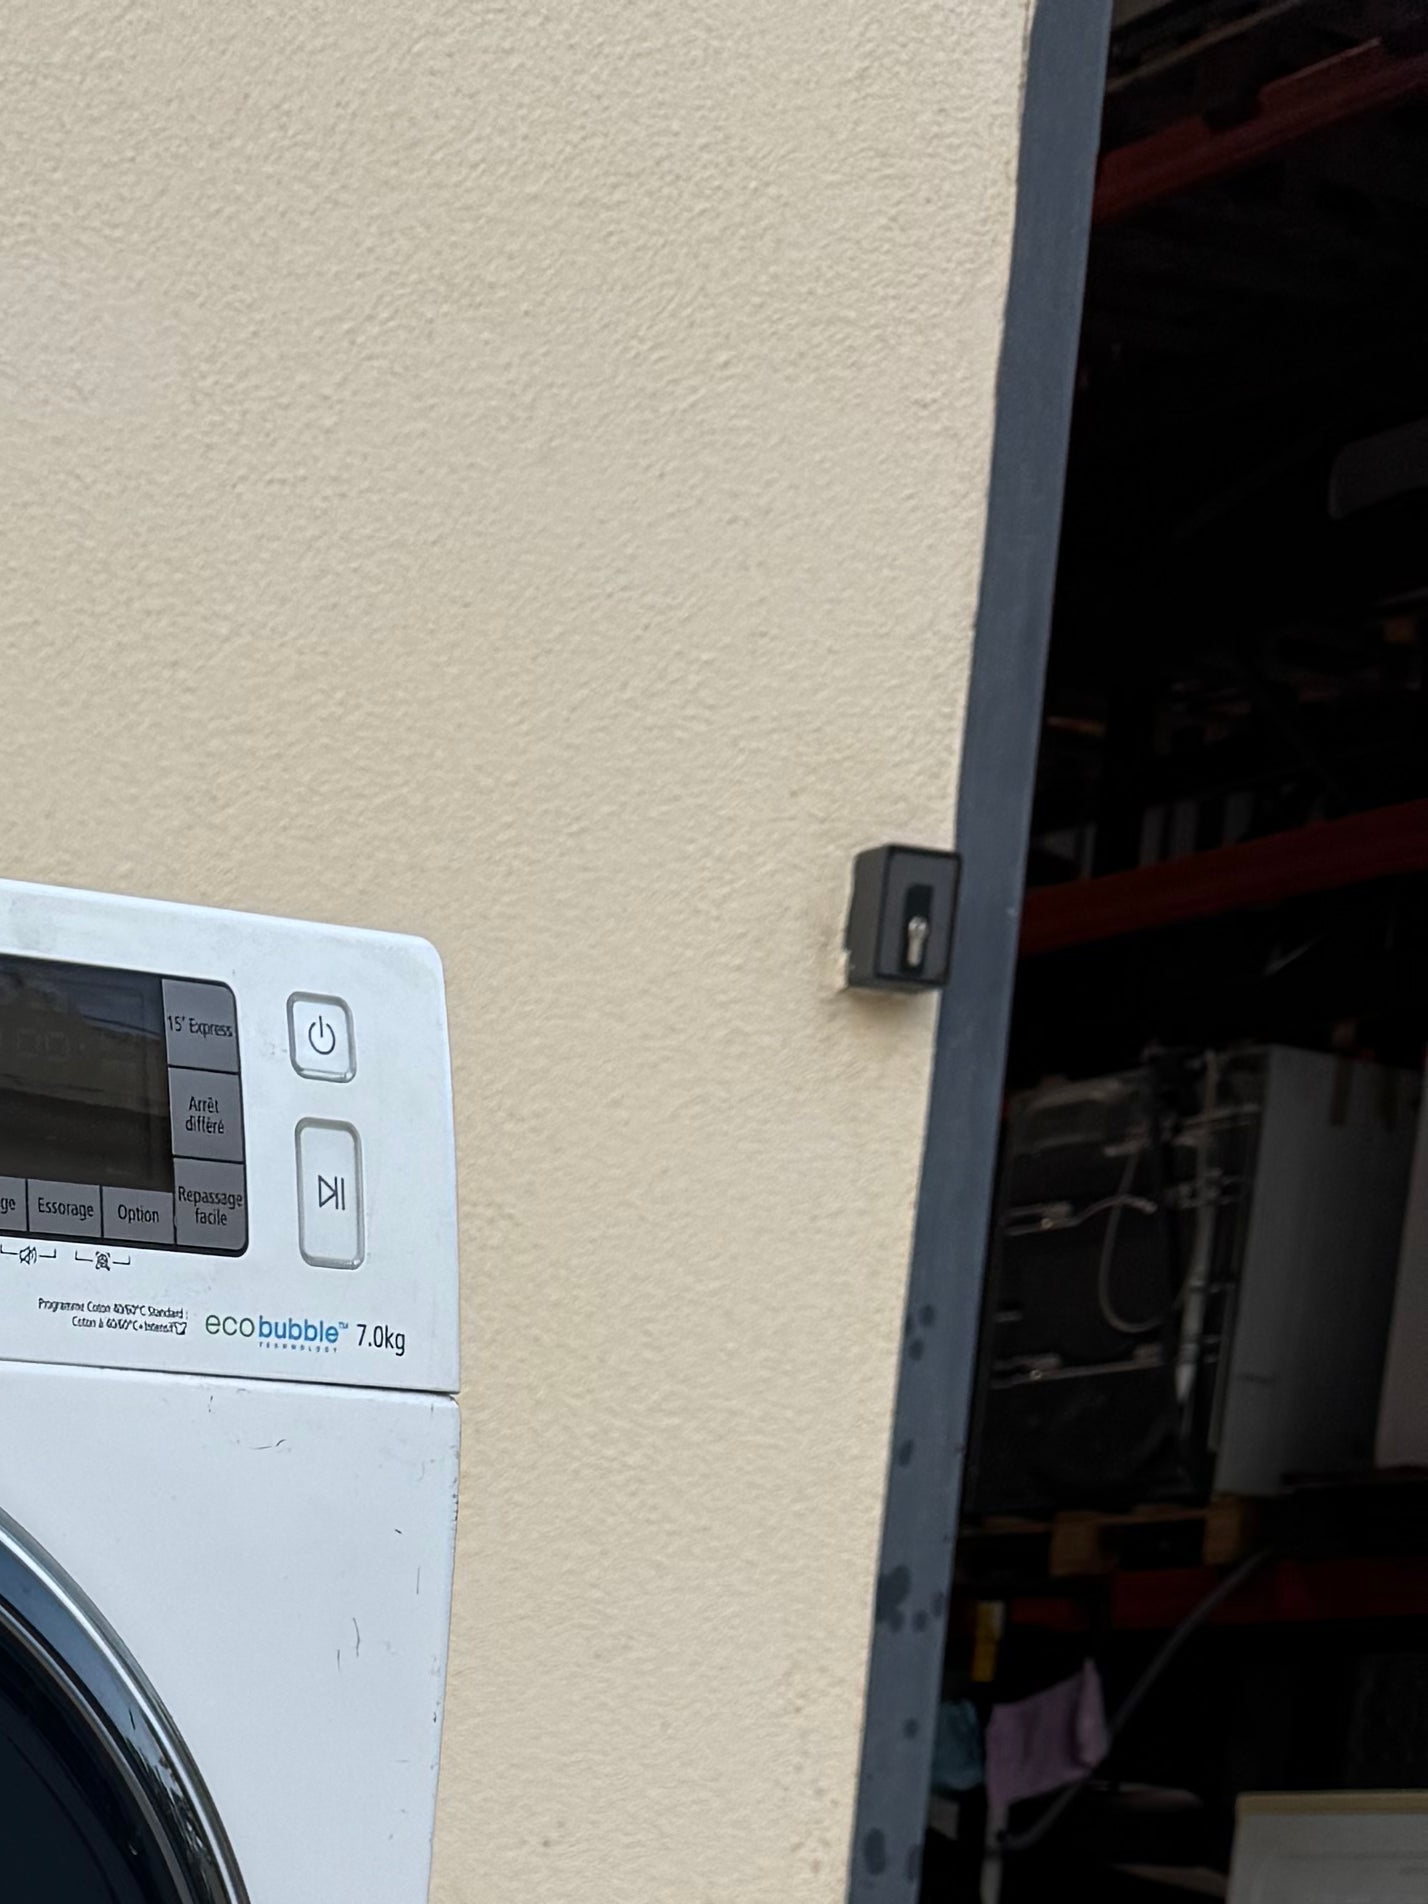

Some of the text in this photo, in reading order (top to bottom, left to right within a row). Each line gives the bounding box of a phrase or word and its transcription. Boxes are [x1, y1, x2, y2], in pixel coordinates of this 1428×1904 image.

[189, 1017, 233, 1039] Express
[189, 1095, 219, 1114] Arrêt
[185, 1115, 225, 1135] différé
[37, 1197, 94, 1219] Essorage
[178, 1186, 243, 1210] Repassage
[118, 1204, 159, 1225] Option
[194, 1207, 227, 1226] facile
[356, 1324, 405, 1356] 7.0kg
